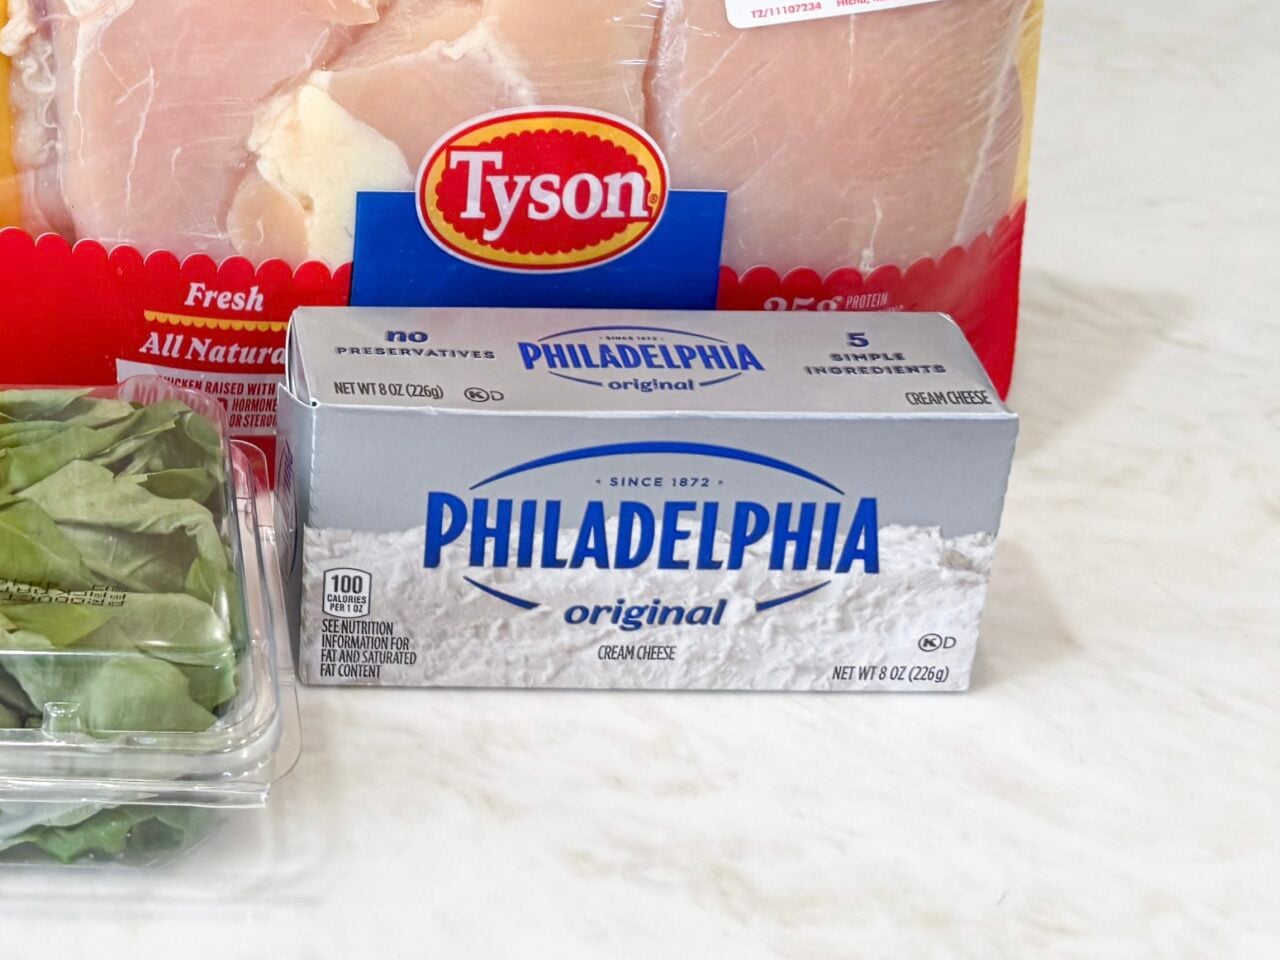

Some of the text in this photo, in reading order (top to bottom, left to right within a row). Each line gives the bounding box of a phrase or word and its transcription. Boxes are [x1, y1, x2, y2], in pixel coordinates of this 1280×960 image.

[449, 149, 652, 241] Tyson
[184, 282, 265, 312] Fresh
[845, 292, 889, 310] PROTEIN
[386, 330, 428, 343] no
[847, 332, 870, 348] 5
[139, 331, 288, 365] All Natura
[336, 346, 497, 360] PRESERVATIVES
[517, 342, 766, 372] PHILADELPHIA
[828, 353, 906, 363] SIMPLE
[804, 364, 947, 376] INGREDIENTS
[205, 381, 276, 396] RAISED WITH
[334, 381, 445, 400] NET WT 8 OZ (226g)
[608, 379, 695, 393] original
[232, 397, 278, 412] HORMONE
[905, 390, 992, 406] CREAM CHEESE
[229, 414, 243, 428] OR
[608, 477, 712, 488] SINCE 1872
[422, 491, 880, 575] PHILADELPHIA
[331, 574, 364, 594] 100
[326, 593, 368, 605] CALORIES
[329, 602, 345, 612] PER
[353, 604, 364, 613] OZ
[563, 598, 728, 632] original
[321, 618, 394, 636] SEE NUTRITION
[321, 634, 410, 651] INFORMATION FOR
[320, 648, 418, 666] FAT AND SATURATED
[597, 645, 678, 662] CREAM CHEESE
[320, 663, 382, 679] FAT CONTENT
[832, 666, 950, 683] NET WT 8 OZ (226g)
